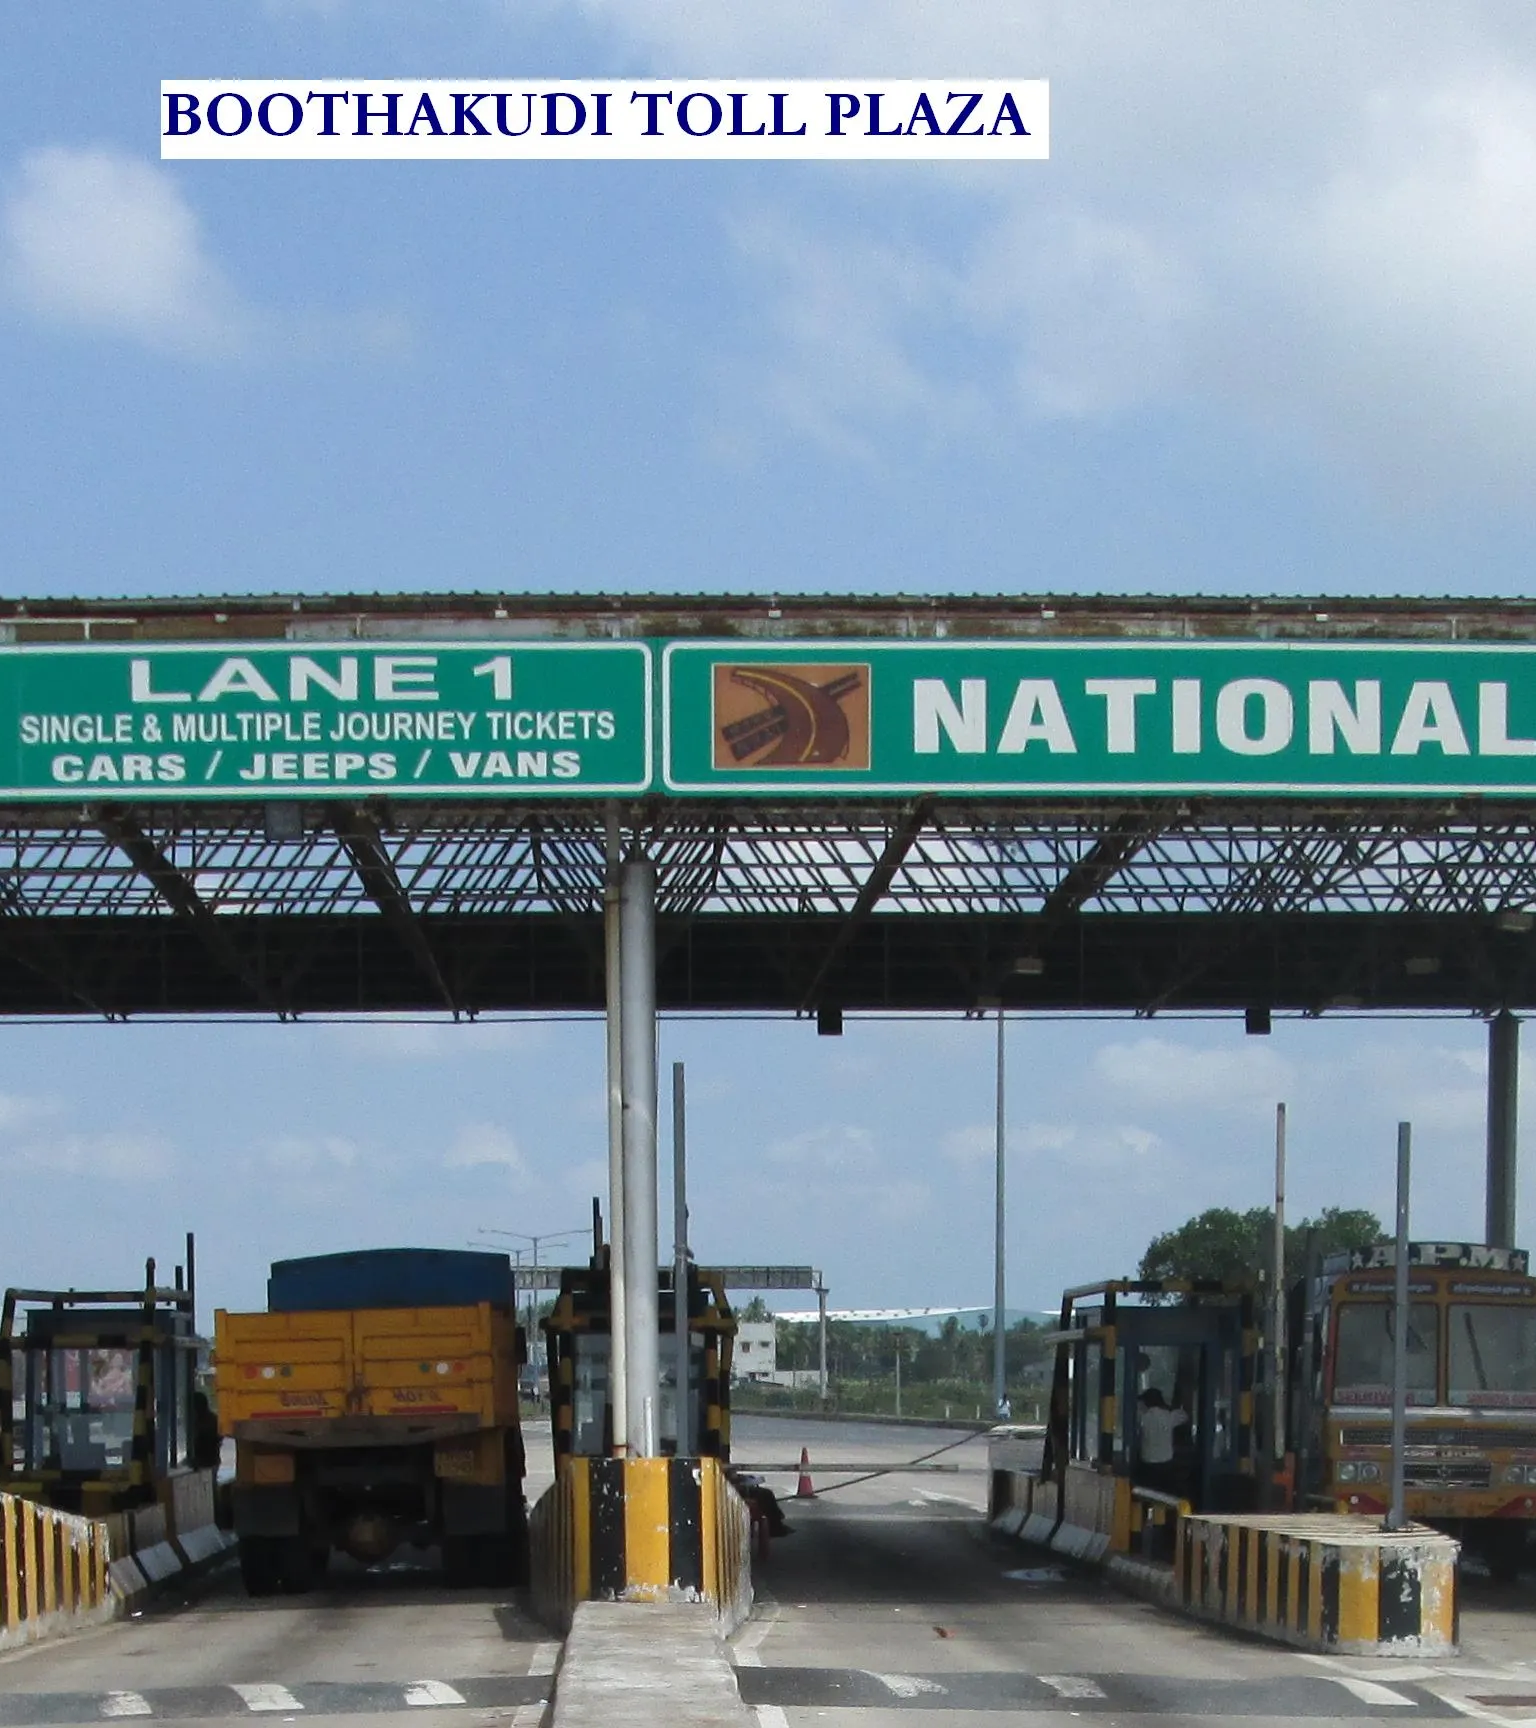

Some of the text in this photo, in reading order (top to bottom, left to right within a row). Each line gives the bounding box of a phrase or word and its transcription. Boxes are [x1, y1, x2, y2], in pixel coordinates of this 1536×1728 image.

[129, 655, 515, 703] LANE 1
[20, 709, 617, 746] SINGLE & MULTIPLE JOURNEY TICKETS
[50, 751, 187, 784] CARS
[238, 750, 398, 782] JEEPS
[447, 749, 582, 780] VANS
